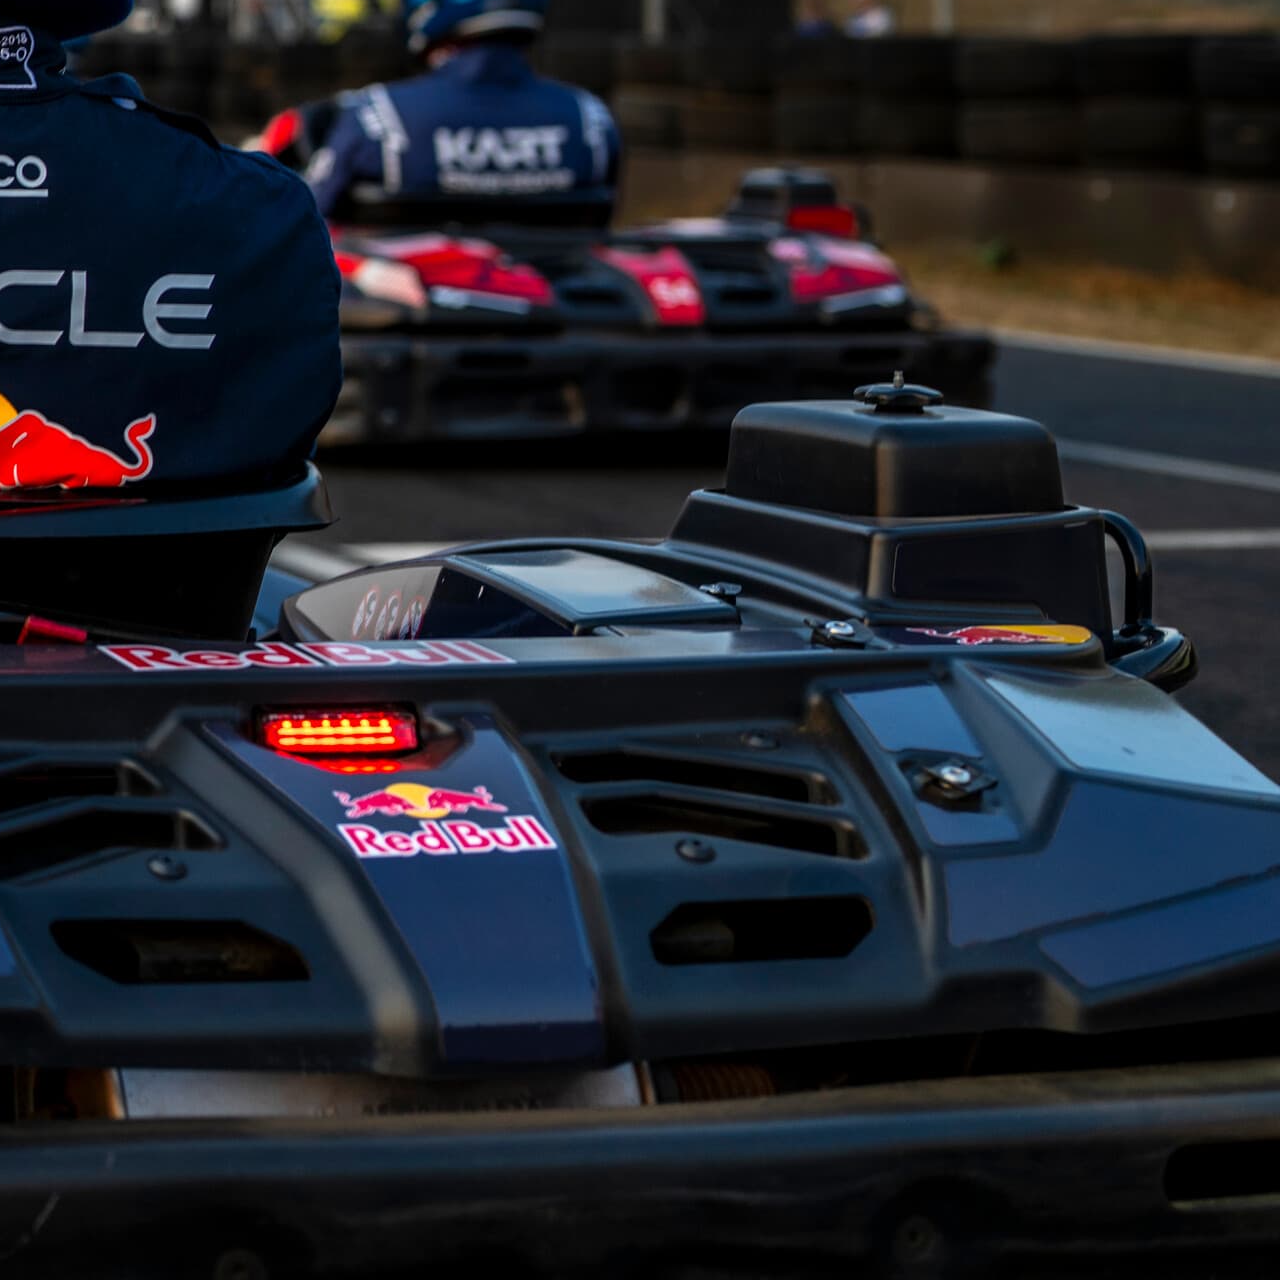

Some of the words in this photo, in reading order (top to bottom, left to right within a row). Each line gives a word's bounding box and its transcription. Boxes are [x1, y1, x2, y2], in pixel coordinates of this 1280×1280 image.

[433, 125, 568, 170] KART
[98, 643, 322, 671] Red
[297, 640, 516, 665] Bull
[338, 820, 457, 858] Red
[441, 815, 558, 853] Bull
